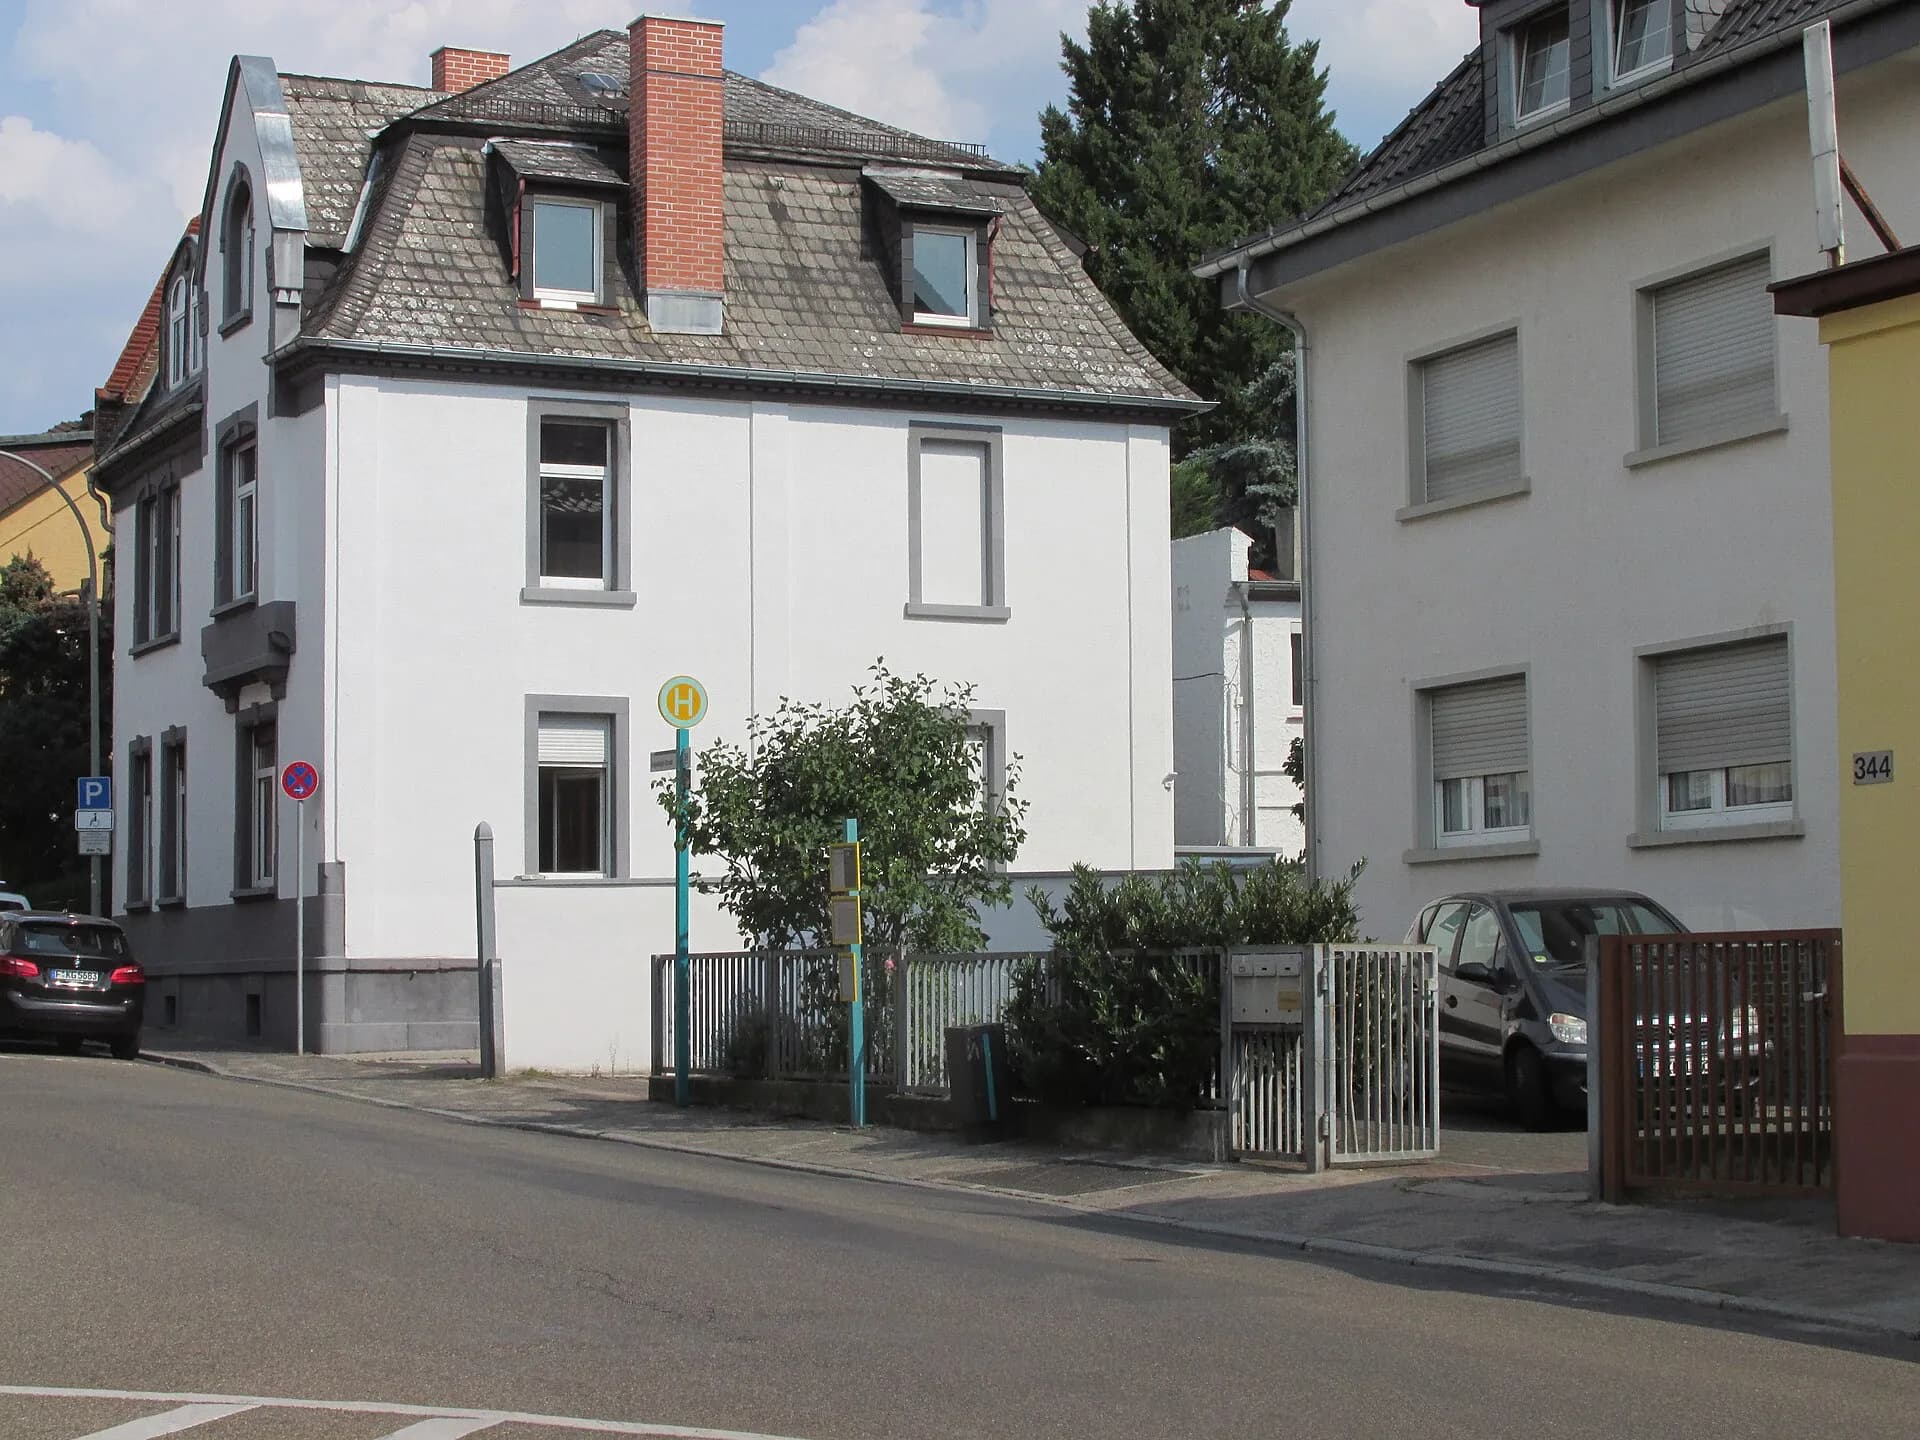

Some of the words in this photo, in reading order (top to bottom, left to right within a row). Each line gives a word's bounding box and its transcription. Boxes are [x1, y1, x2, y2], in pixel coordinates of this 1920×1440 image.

[674, 687, 693, 716] H
[1855, 755, 1891, 779] 344
[86, 781, 103, 806] P
